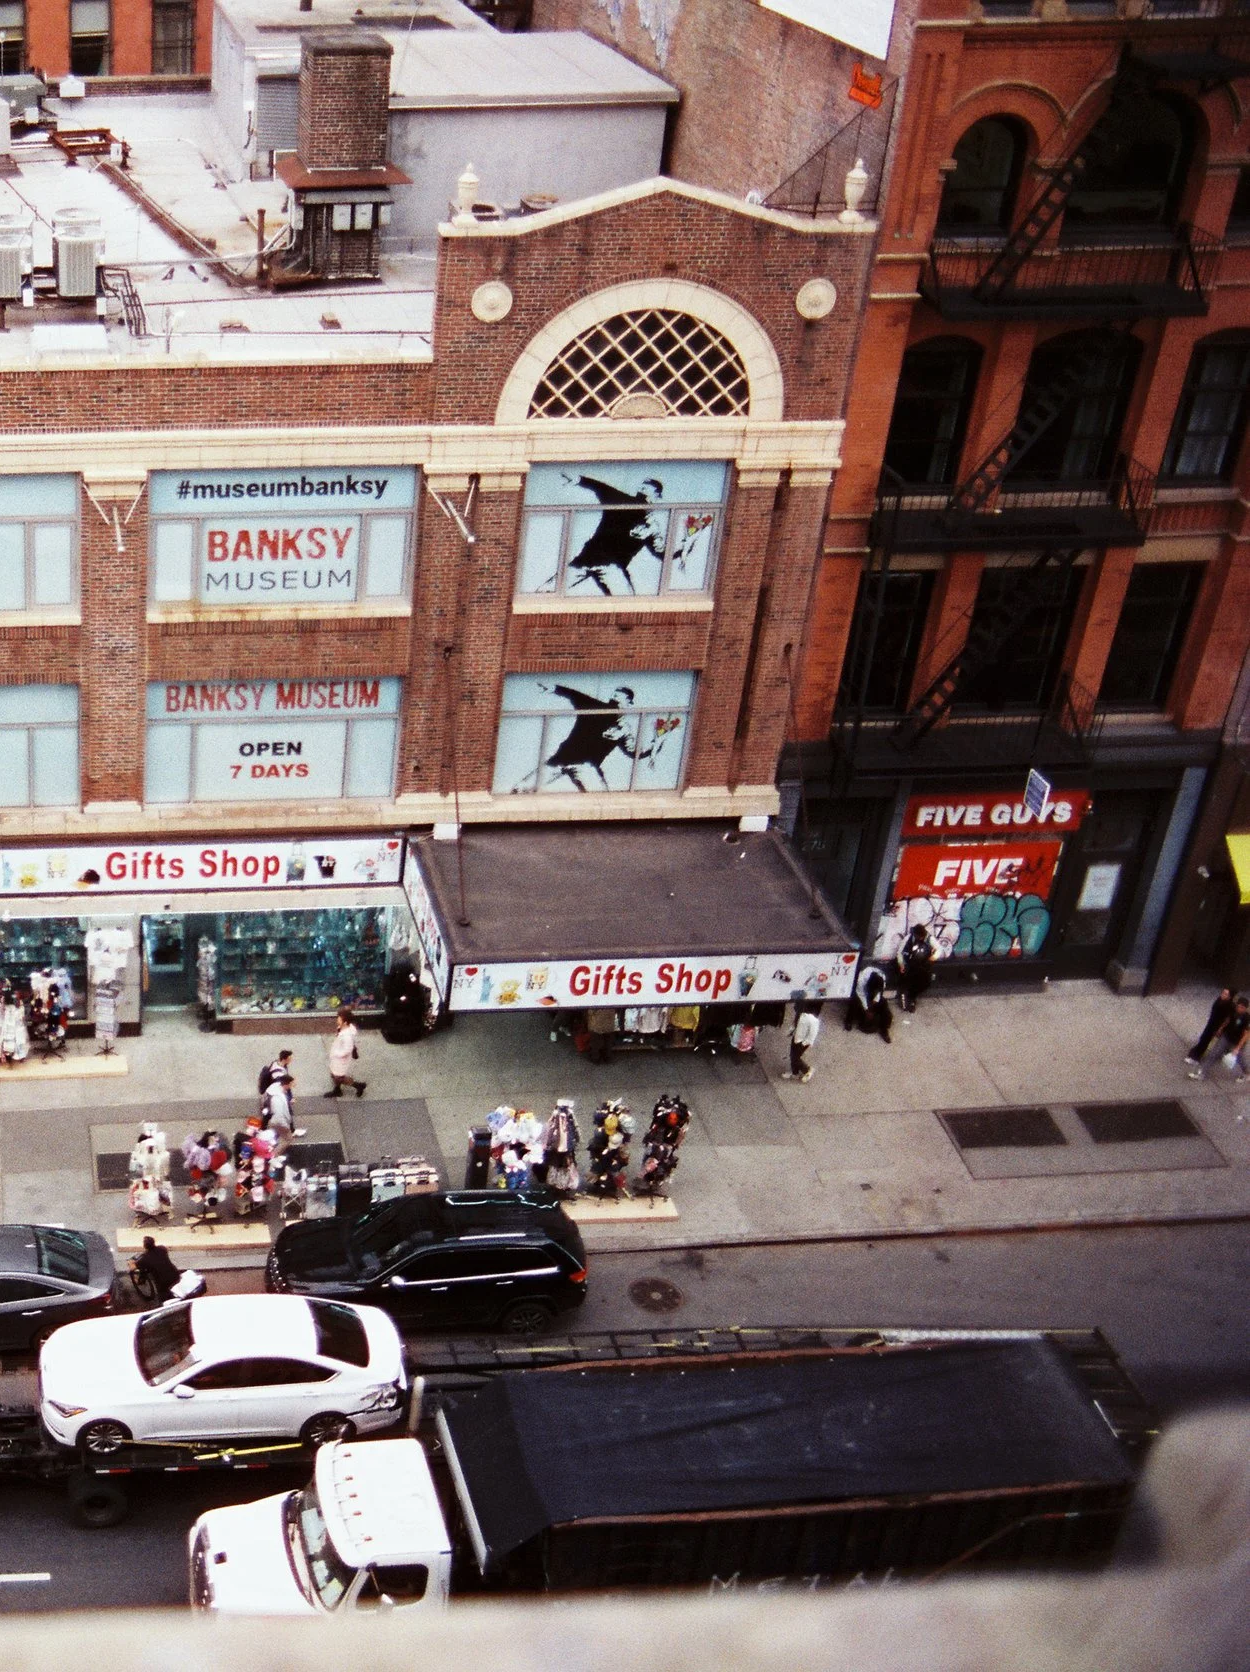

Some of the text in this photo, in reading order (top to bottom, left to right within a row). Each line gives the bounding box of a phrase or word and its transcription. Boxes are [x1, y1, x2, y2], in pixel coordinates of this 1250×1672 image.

[176, 474, 388, 500] #museumbanksy
[207, 527, 354, 562] BANKSY
[206, 569, 352, 592] MUSEUM
[165, 680, 381, 713] BANKSY MUSEUM
[239, 742, 302, 757] OPEN
[230, 764, 309, 779] 7 DAYS
[915, 801, 1072, 828] FIVE GUYS
[105, 849, 280, 884] Gifts Shop
[932, 857, 1024, 887] FIVE
[569, 963, 732, 1000] Gifts Shop
